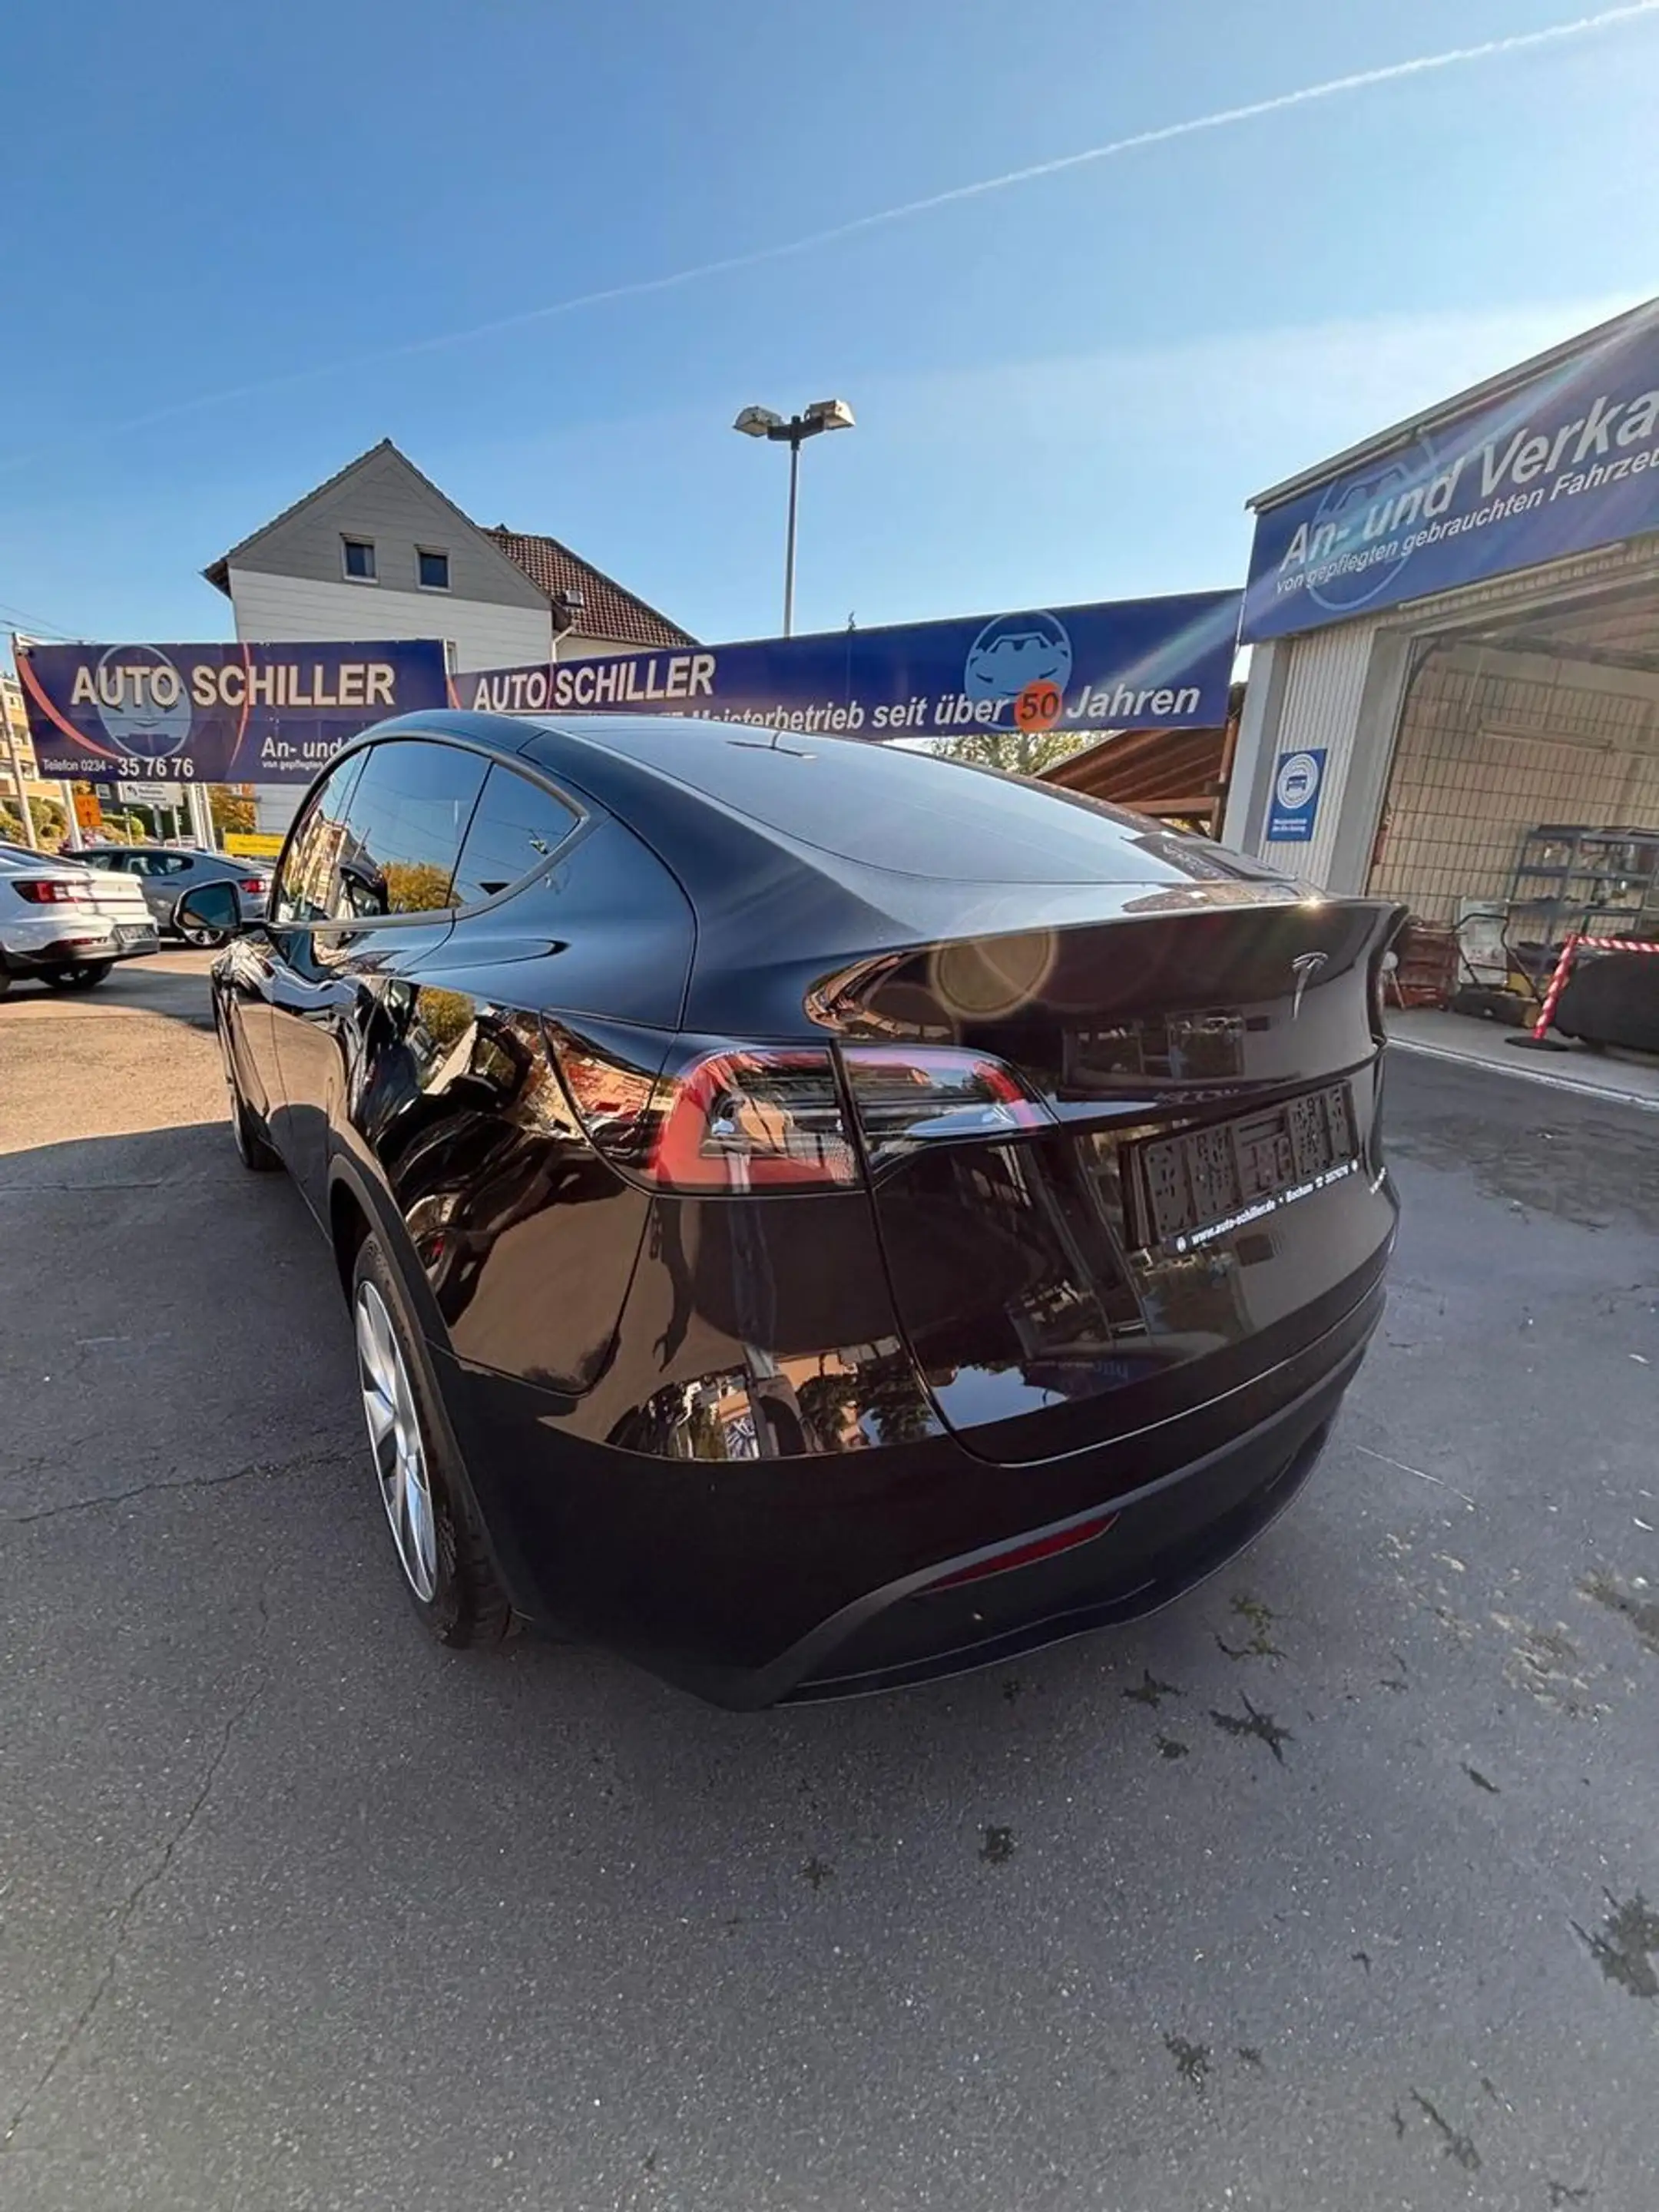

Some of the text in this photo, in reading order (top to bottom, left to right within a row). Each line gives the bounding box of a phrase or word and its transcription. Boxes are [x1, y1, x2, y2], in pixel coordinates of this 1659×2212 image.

[1279, 390, 1659, 573] An- und Verka
[1277, 574, 1305, 594] von
[1306, 539, 1399, 589] gepflegten
[1401, 488, 1545, 557] gebrauchten
[71, 664, 396, 707] AUTO SCHILLER
[473, 654, 717, 711] AUTO SCHILLER
[872, 697, 928, 728] seit
[934, 696, 1011, 726] über
[1021, 692, 1059, 720] 50
[1066, 684, 1201, 719] Jahren
[42, 757, 79, 772] Telefon
[81, 758, 107, 772] 0234
[118, 757, 140, 776] 35
[144, 757, 167, 777] 76
[171, 757, 195, 777] 76
[261, 737, 343, 758] An- und
